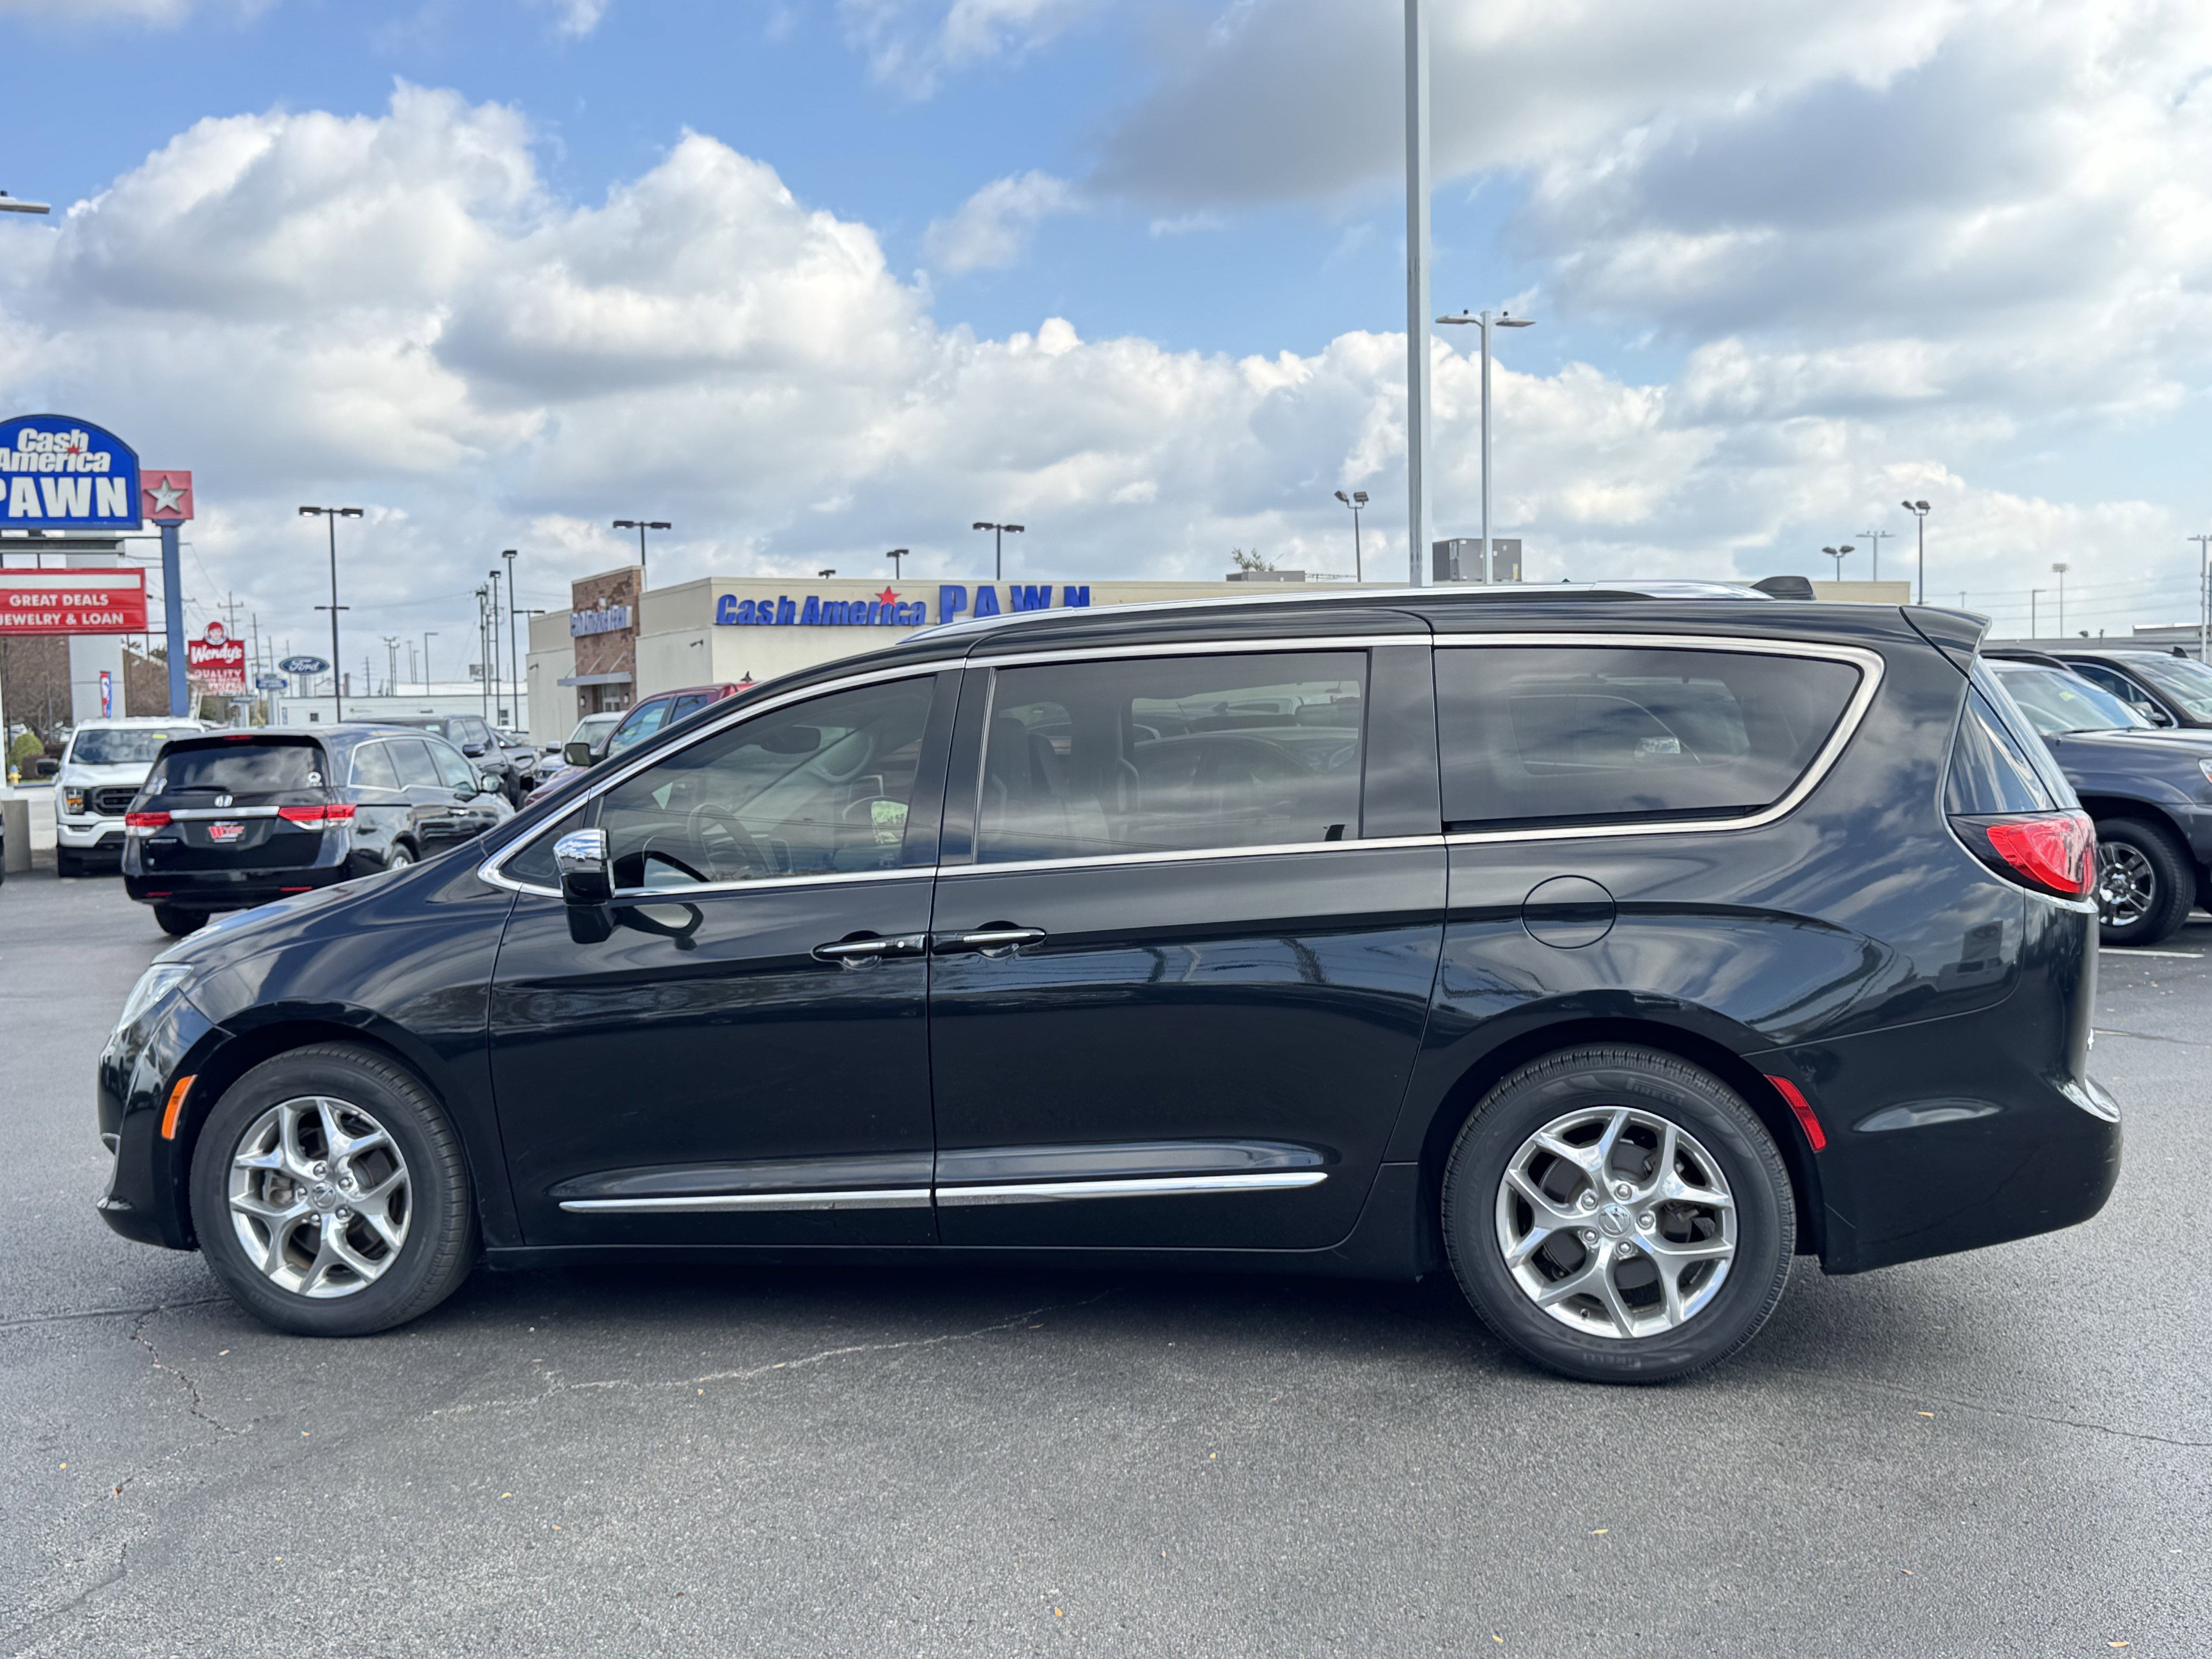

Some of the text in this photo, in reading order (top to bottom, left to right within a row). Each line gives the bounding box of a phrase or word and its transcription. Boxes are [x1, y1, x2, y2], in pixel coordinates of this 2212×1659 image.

[17, 428, 89, 453] Cash
[0, 477, 128, 517] AWN
[9, 593, 109, 607] GREAT DEALS
[716, 594, 797, 625] Cash
[800, 595, 927, 625] America
[66, 613, 77, 625] &
[81, 612, 124, 625] LOAN
[289, 659, 320, 672] Ford
